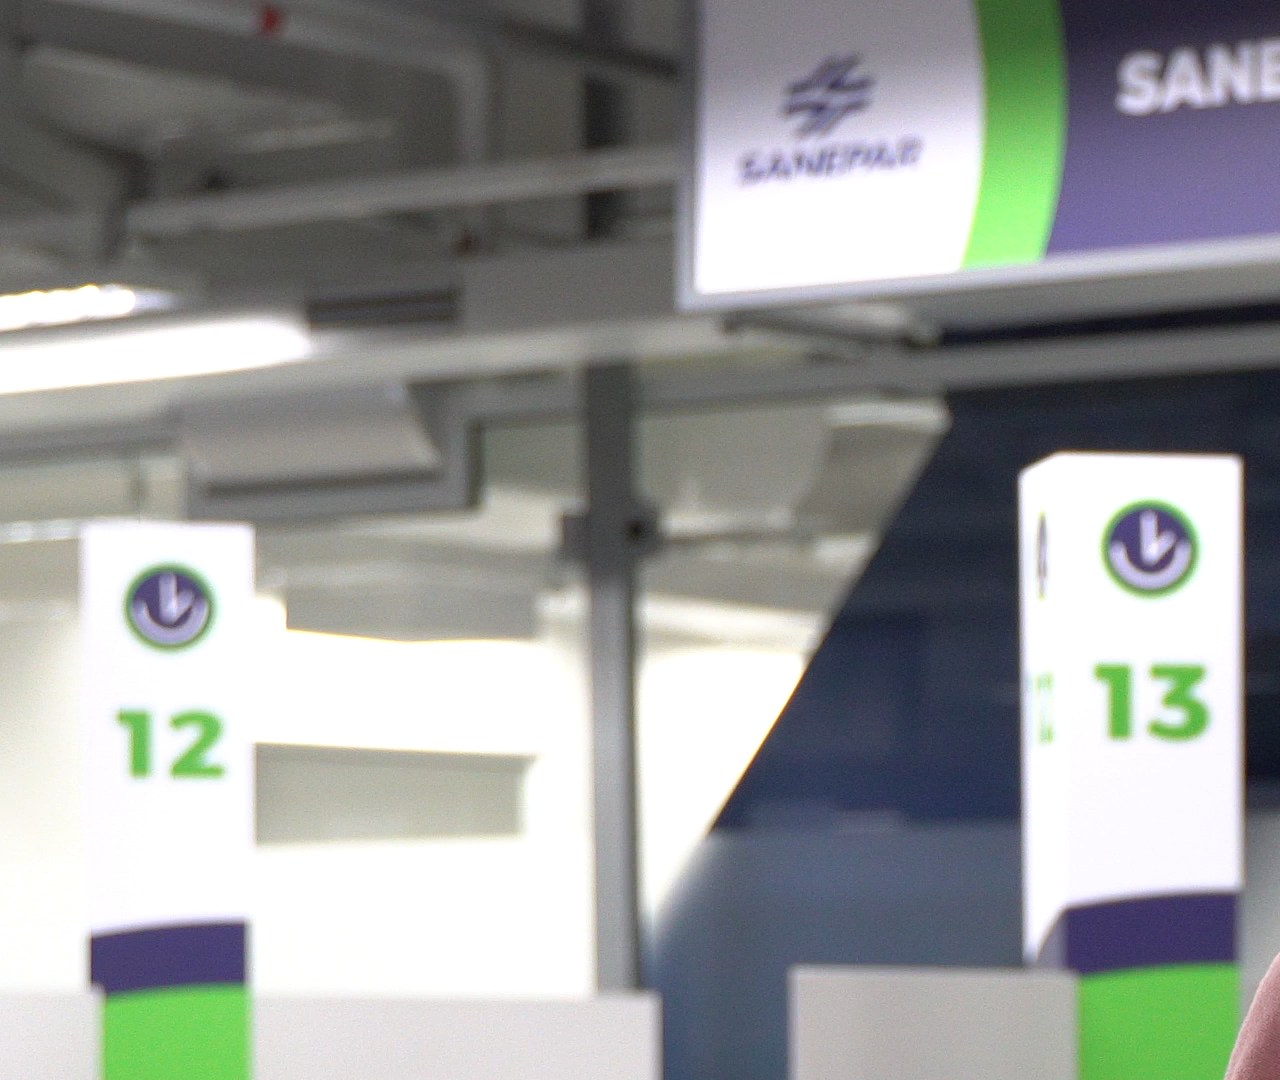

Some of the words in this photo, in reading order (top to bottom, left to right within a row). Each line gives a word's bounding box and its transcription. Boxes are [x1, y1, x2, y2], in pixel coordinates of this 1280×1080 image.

[737, 134, 922, 187] SANEPAR
[1094, 662, 1210, 742] 13
[117, 708, 226, 779] 12
